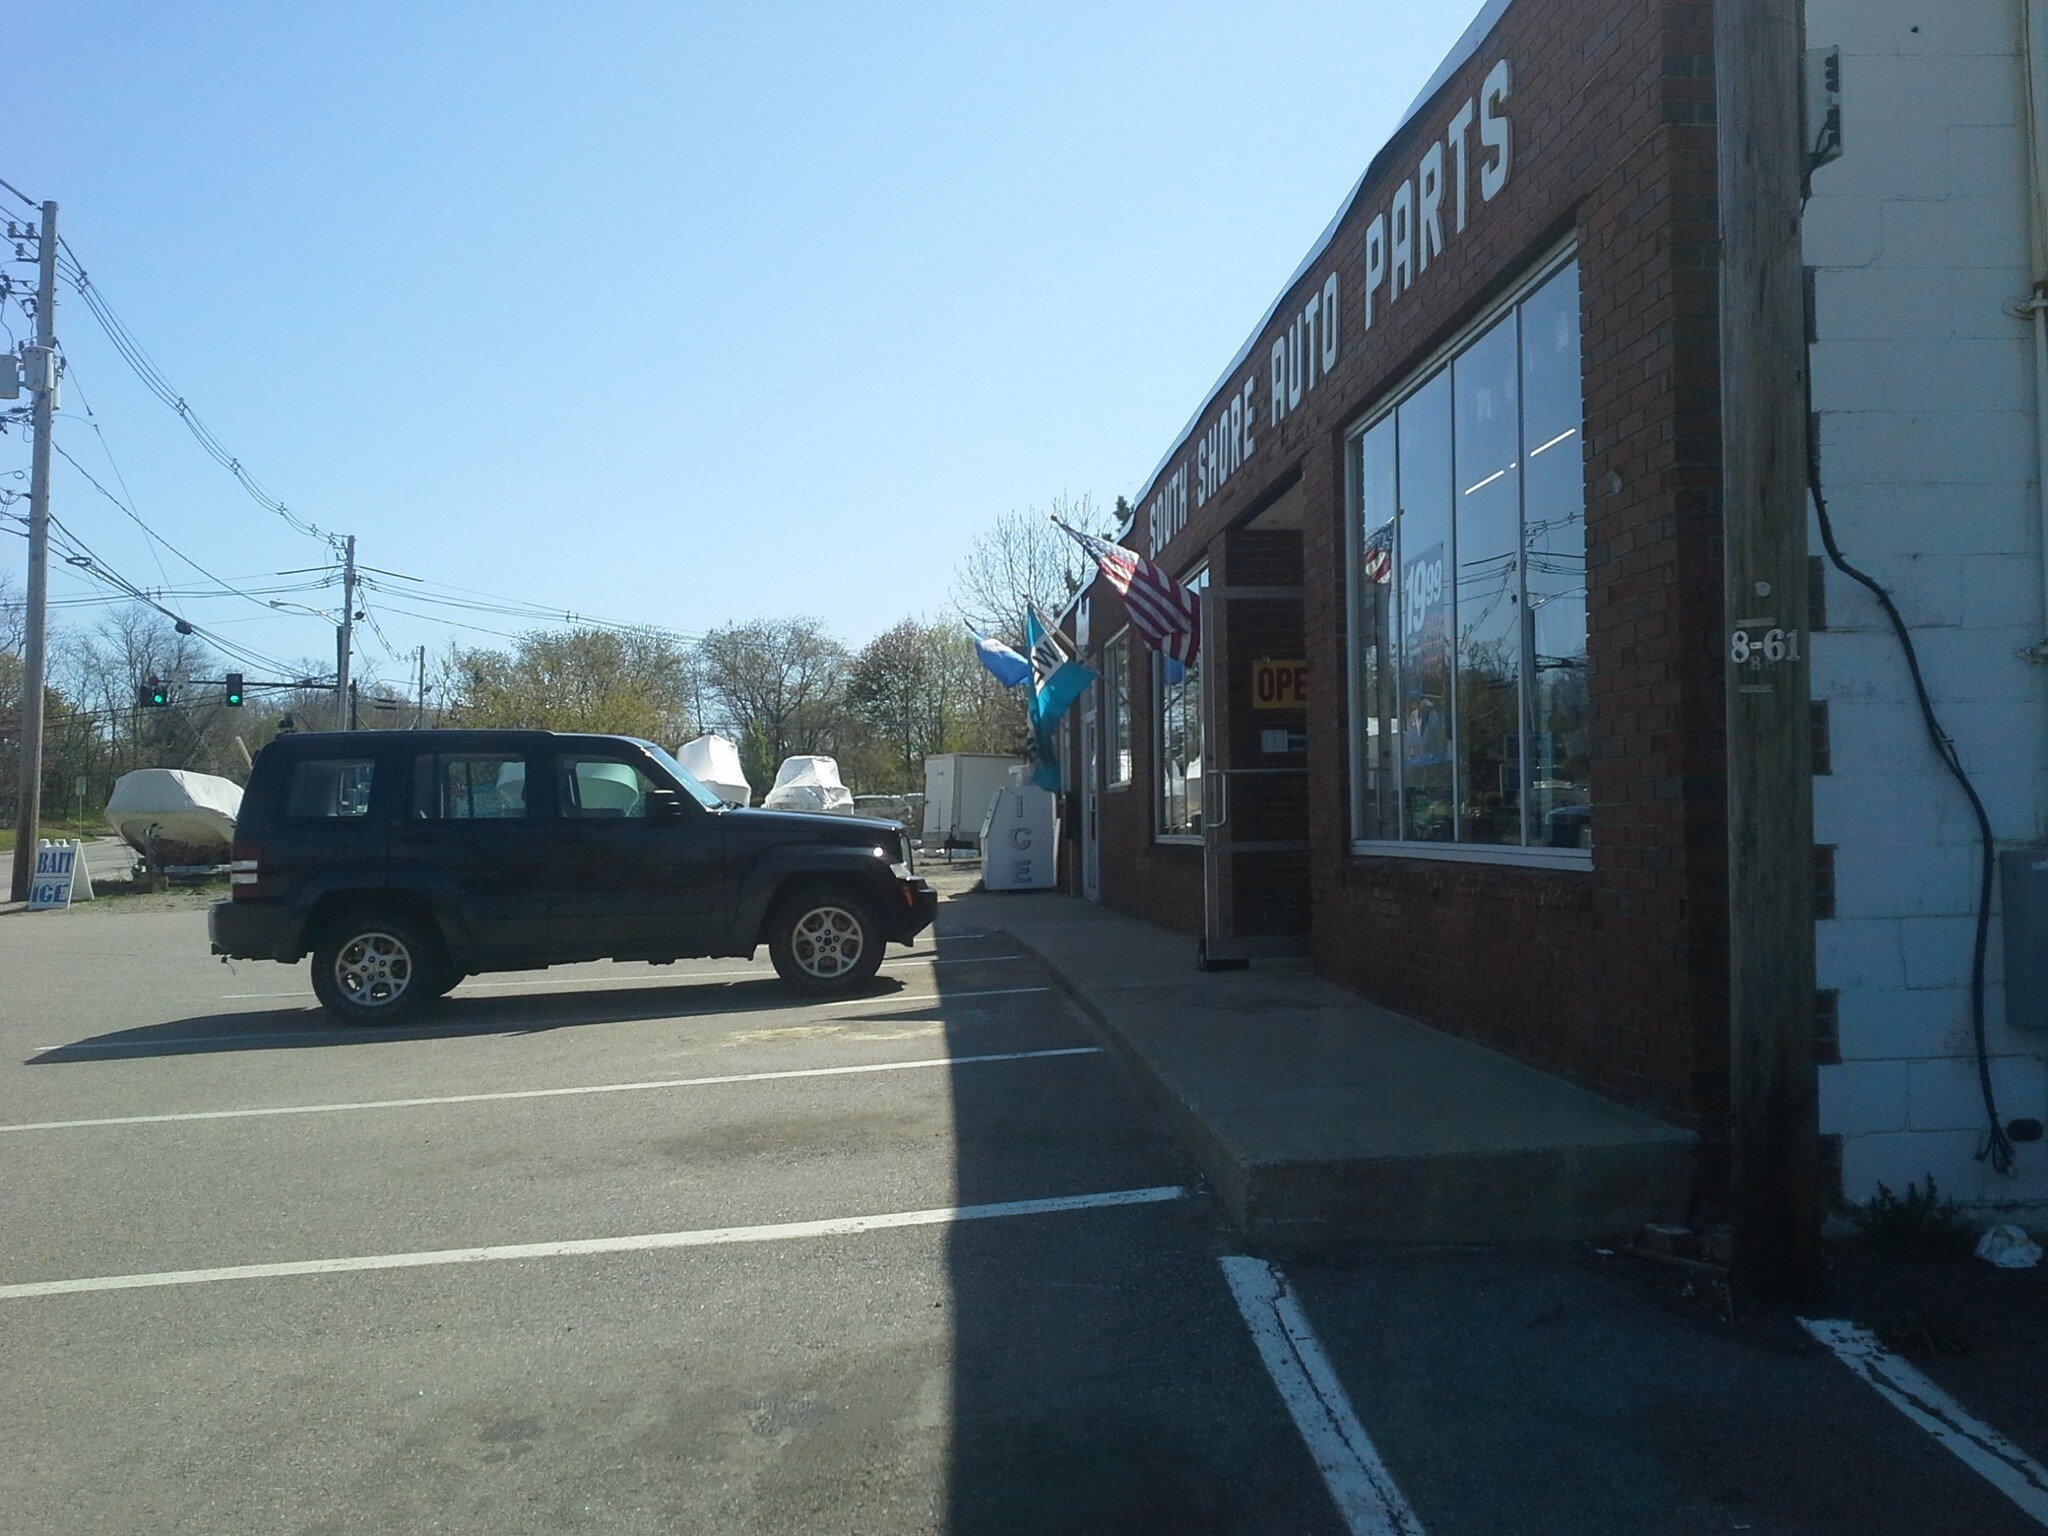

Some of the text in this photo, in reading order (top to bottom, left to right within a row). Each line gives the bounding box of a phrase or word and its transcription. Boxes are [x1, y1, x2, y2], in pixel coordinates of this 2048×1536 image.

[1149, 58, 1510, 561] SOUTH SHORE AUTO PARTS
[1730, 628, 1801, 664] 8-61
[1010, 793, 1033, 884] ICE
[36, 852, 75, 874] BAIT
[31, 882, 69, 903] ICE
